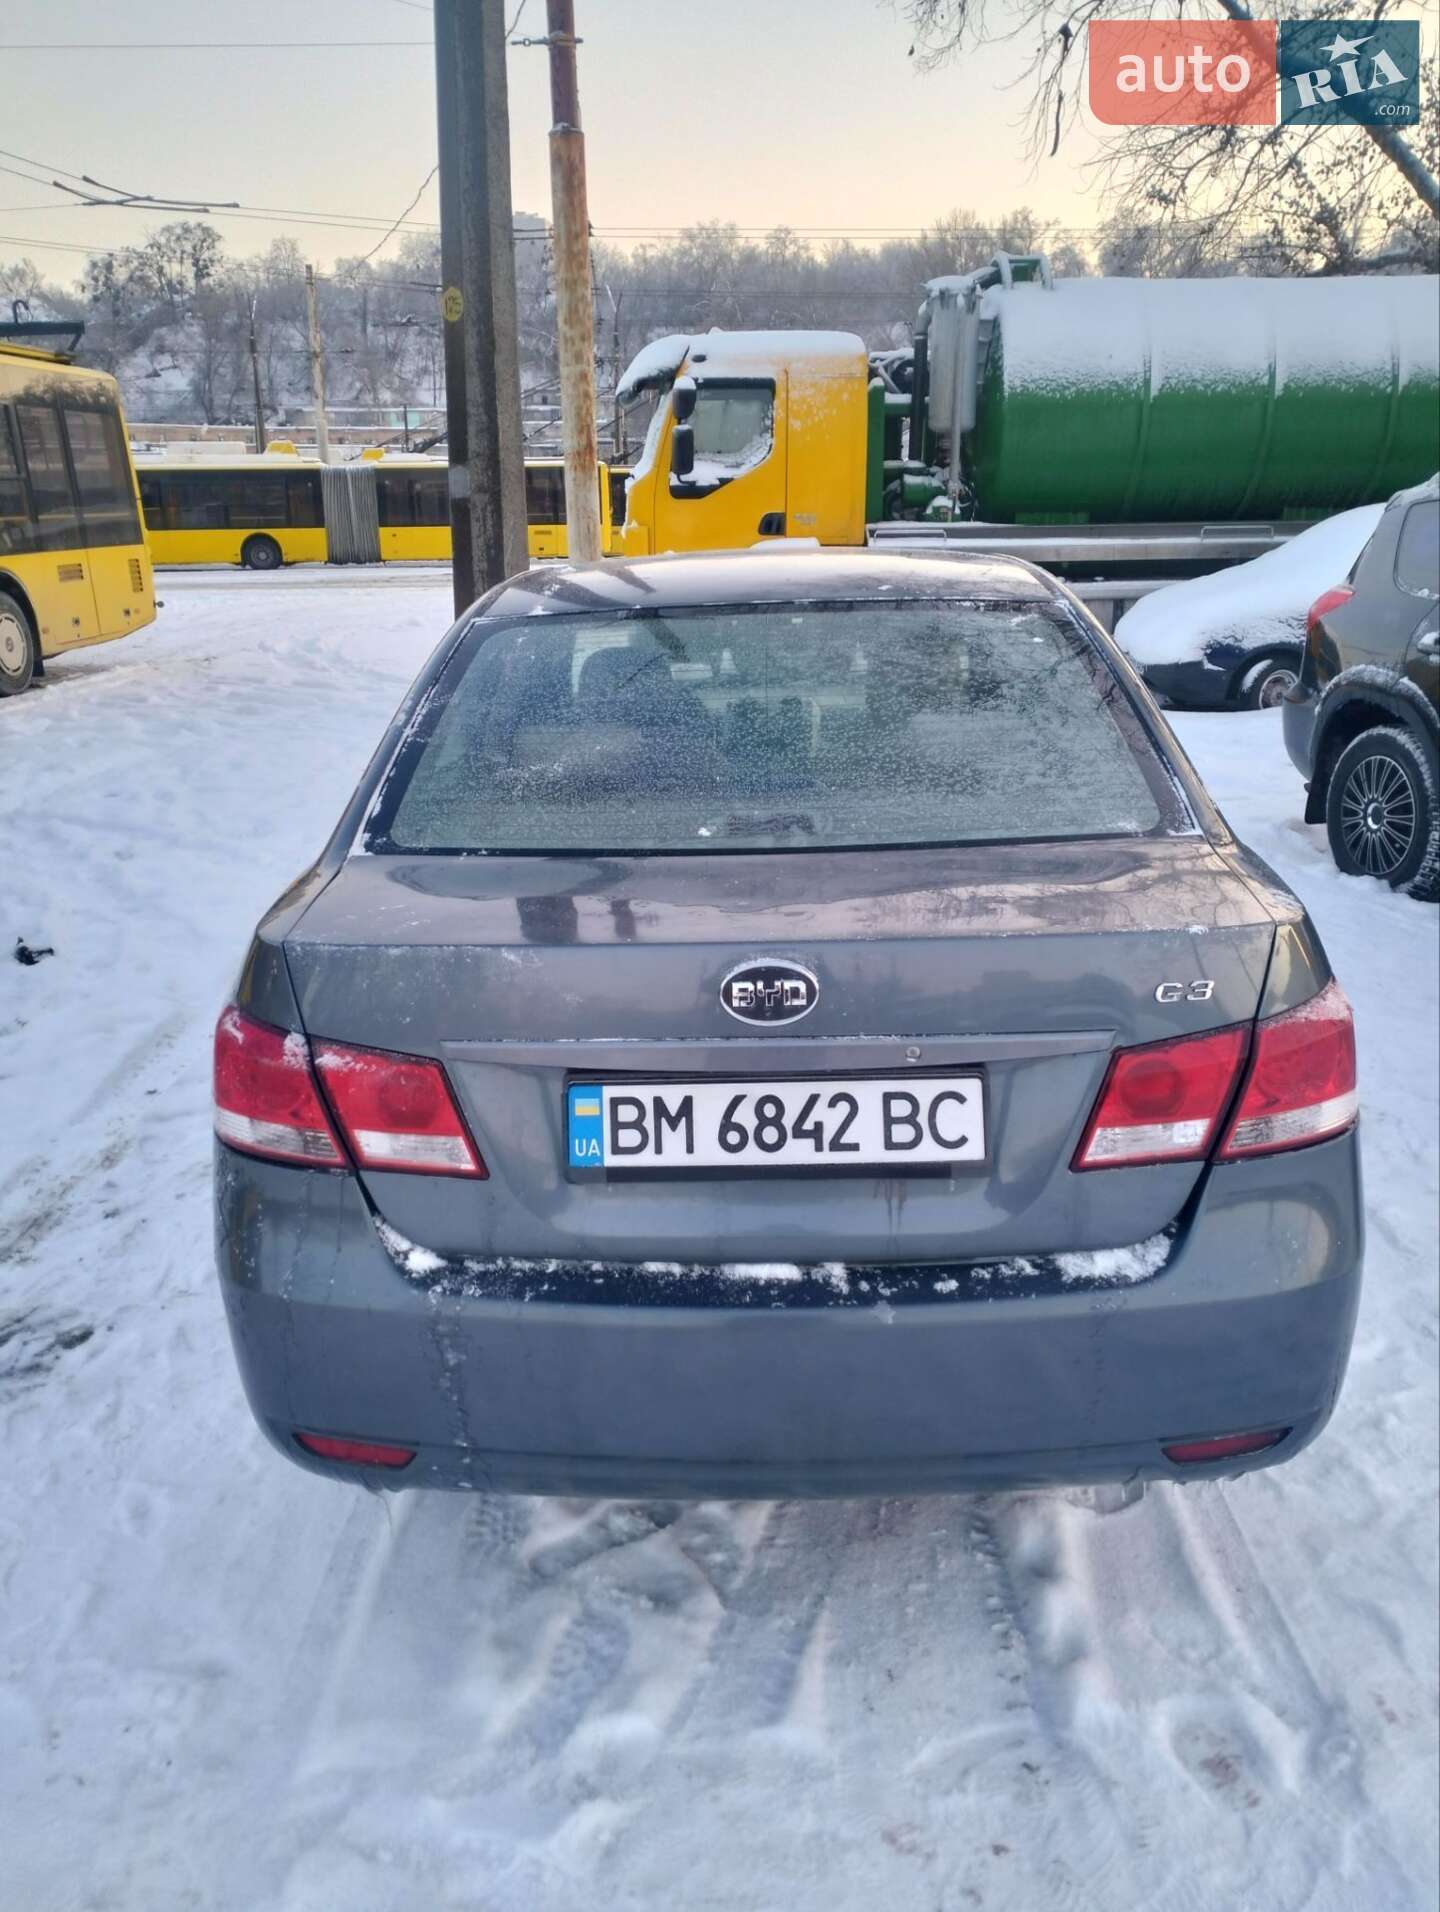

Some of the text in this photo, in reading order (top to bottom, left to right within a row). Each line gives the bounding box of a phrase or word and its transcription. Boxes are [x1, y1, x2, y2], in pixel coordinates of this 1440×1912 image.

[731, 980, 807, 1008] BYD
[1155, 980, 1215, 1003] G3
[608, 1091, 969, 1156] BM 6842 BC
[575, 1138, 601, 1157] UA
